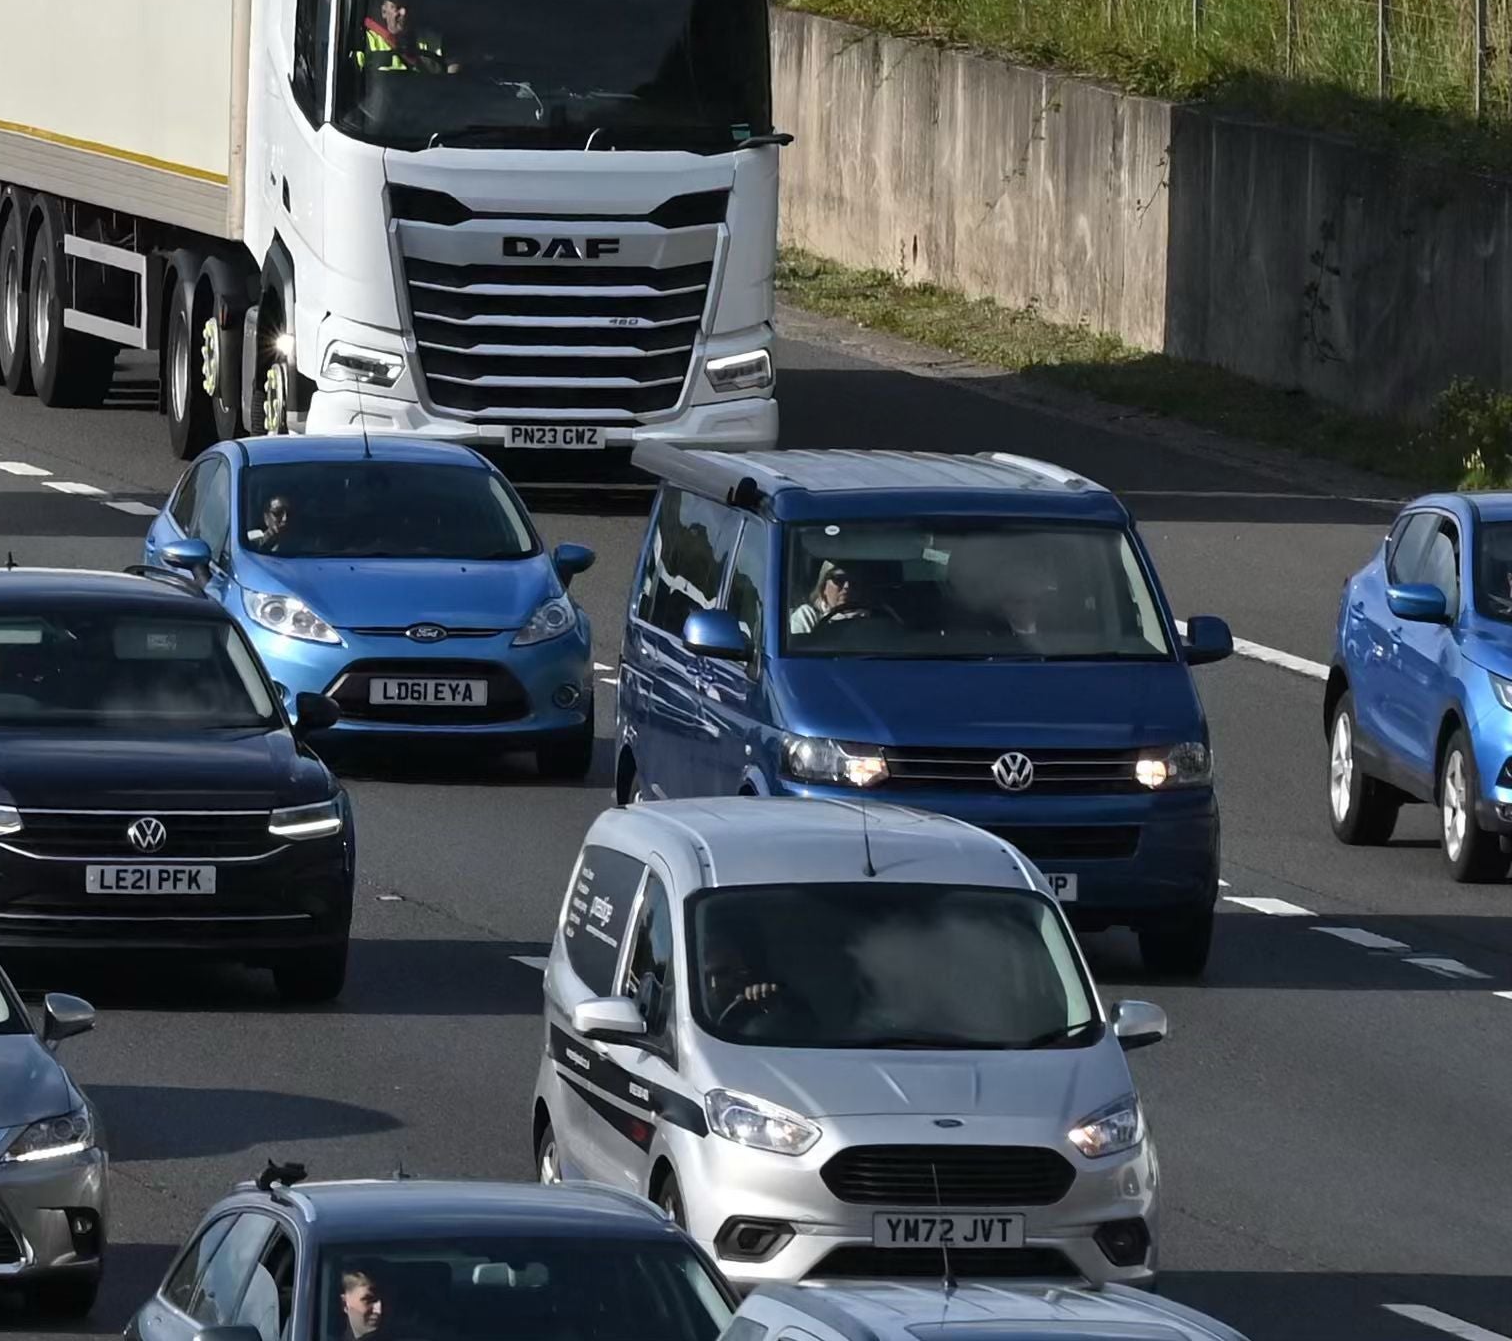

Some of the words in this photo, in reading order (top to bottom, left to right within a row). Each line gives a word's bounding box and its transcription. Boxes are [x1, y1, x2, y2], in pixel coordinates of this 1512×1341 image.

[502, 236, 621, 259] DAF
[512, 427, 558, 445] PN23
[562, 427, 598, 446] GWZ
[99, 866, 151, 892] LE21
[157, 866, 202, 892] PFK
[886, 1217, 954, 1243] YM72
[963, 1217, 1012, 1243] JVT
